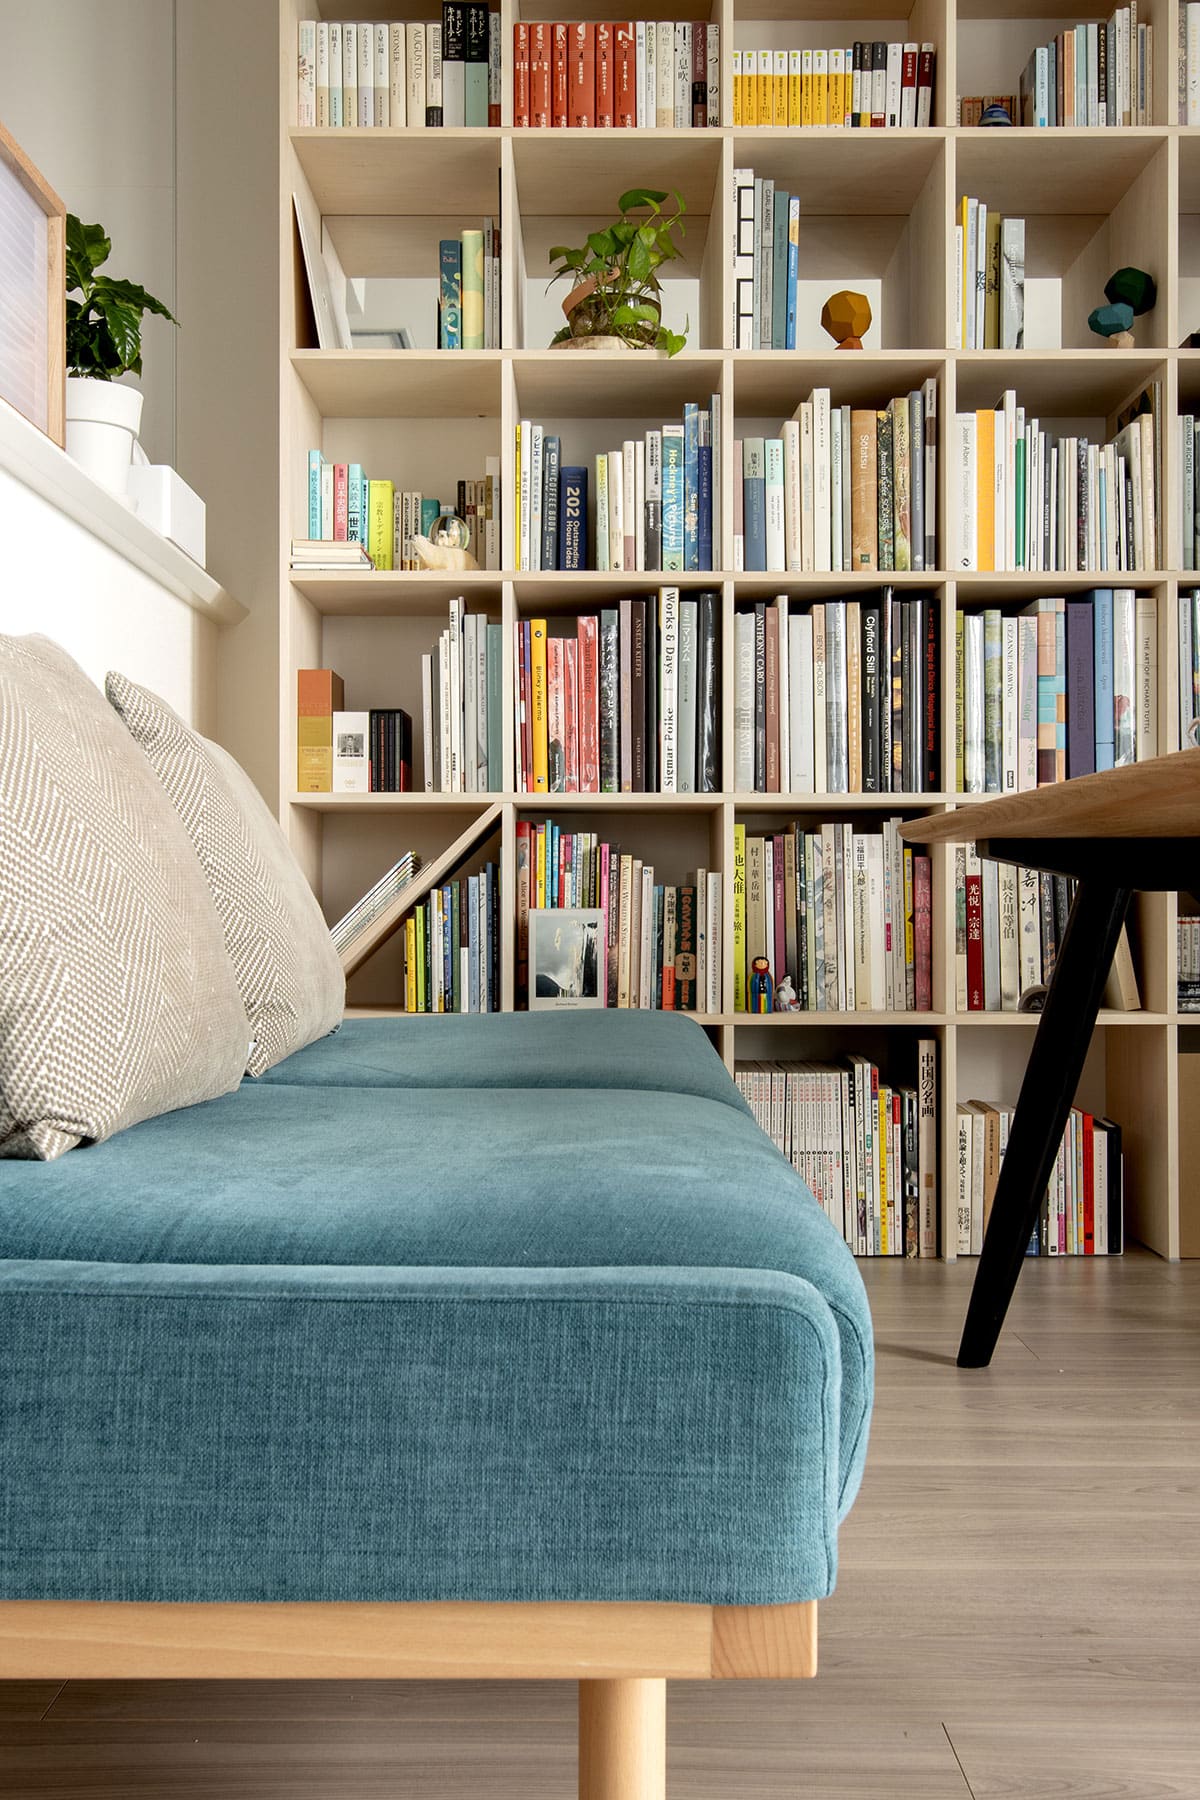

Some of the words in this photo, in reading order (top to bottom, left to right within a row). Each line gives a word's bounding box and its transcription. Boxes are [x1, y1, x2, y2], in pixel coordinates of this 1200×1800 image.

[414, 28, 422, 80] AUGUSTUS
[962, 427, 970, 444] Josef
[880, 450, 888, 475] Anselm
[962, 445, 970, 467] Albers
[549, 477, 557, 508] COFFEE
[667, 449, 679, 503] Hockney's
[881, 476, 889, 496] Kiefer
[566, 486, 580, 517] 202
[690, 494, 698, 512] Sam
[376, 502, 384, 552] 宗教とデザイン
[548, 510, 556, 532] BOOK
[668, 504, 680, 547] Pictures
[572, 520, 580, 568] Outstanding
[665, 592, 675, 630] Works
[682, 608, 691, 662] ミニマリズム
[756, 613, 764, 657] ANTHONY
[864, 616, 876, 654] Clyfford
[926, 642, 935, 662] Giorgio
[535, 666, 543, 688] Blinky
[663, 646, 676, 675] Days
[739, 641, 751, 684] ROBERT
[756, 658, 764, 683] CARO
[867, 656, 876, 673] Still
[1144, 666, 1150, 675] OF
[739, 685, 752, 766] MOTHERWELL
[927, 693, 935, 729] Metaphysical
[927, 729, 935, 751] Journey
[664, 745, 674, 787] Sigmar
[750, 847, 761, 902] 村上華岳展
[857, 846, 865, 886] 福田平八郎
[521, 899, 527, 908] in
[968, 883, 980, 941] 光悦・宗達
[1002, 879, 1015, 940] 長谷川等伯
[921, 1052, 935, 1118] 中国の名画
